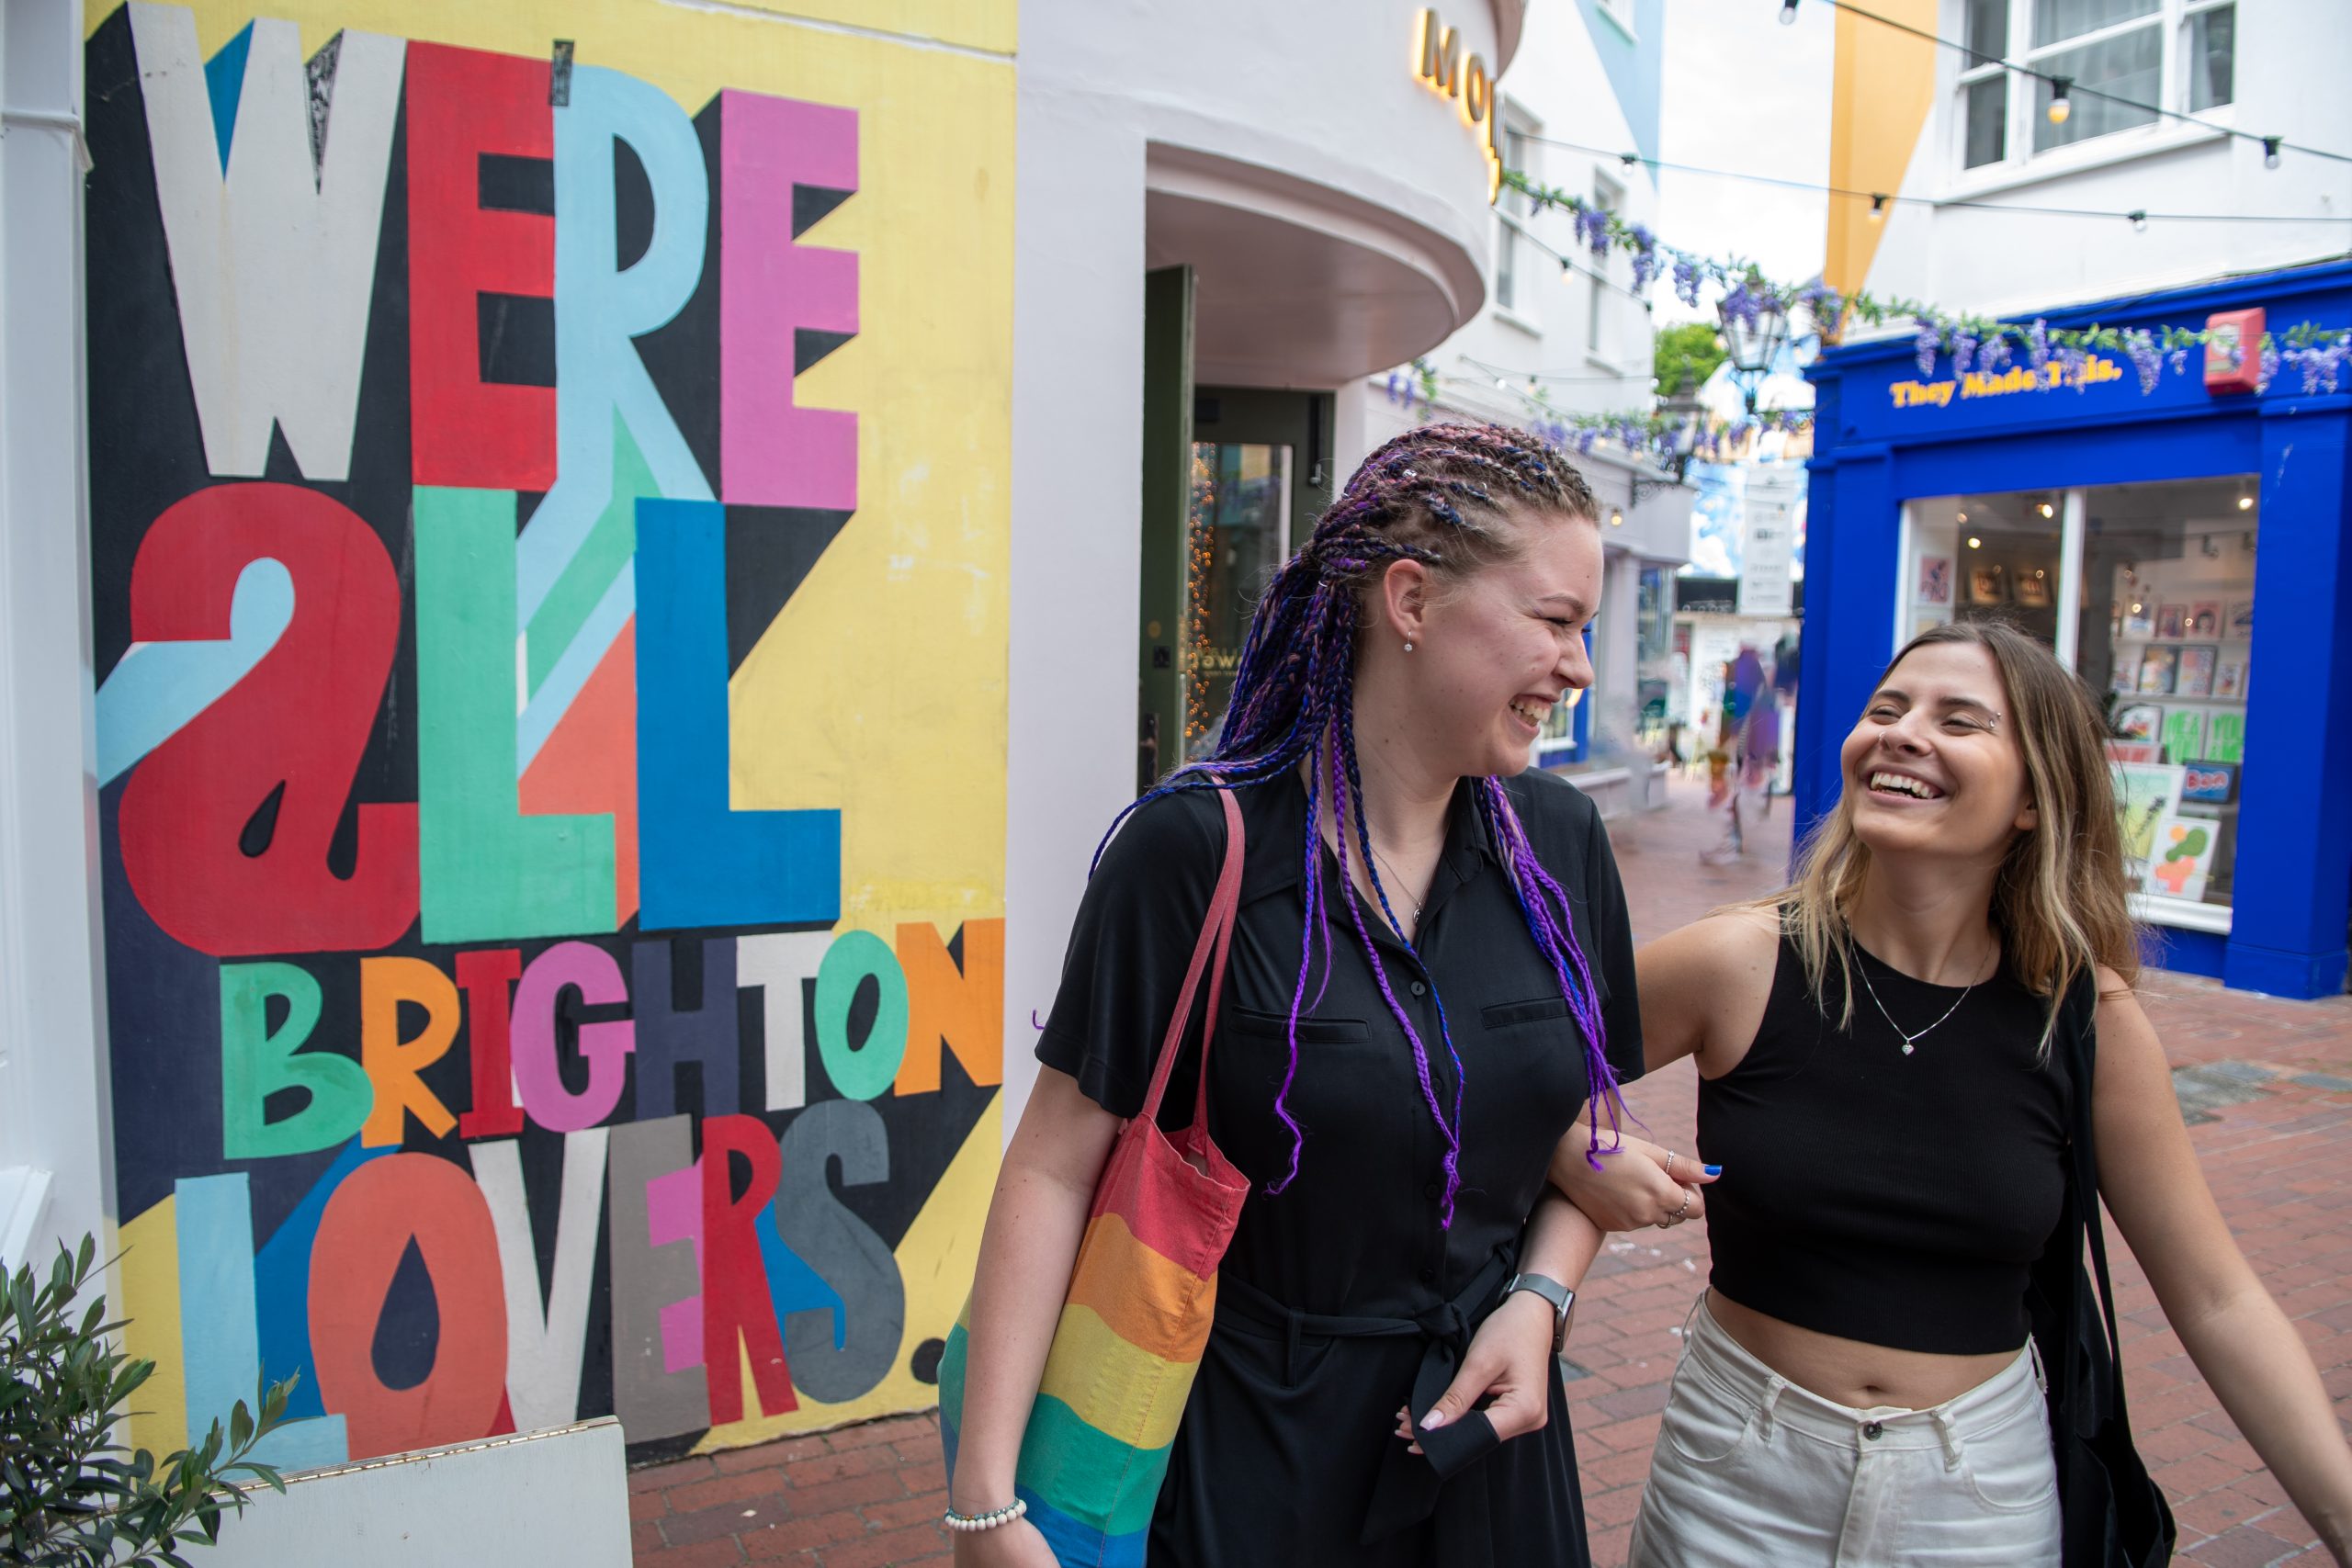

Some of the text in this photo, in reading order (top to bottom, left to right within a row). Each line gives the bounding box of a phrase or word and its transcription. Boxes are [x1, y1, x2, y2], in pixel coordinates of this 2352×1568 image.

[1890, 354, 2123, 408] They Made Tis.
[220, 918, 1006, 1160] BRIGHTON
